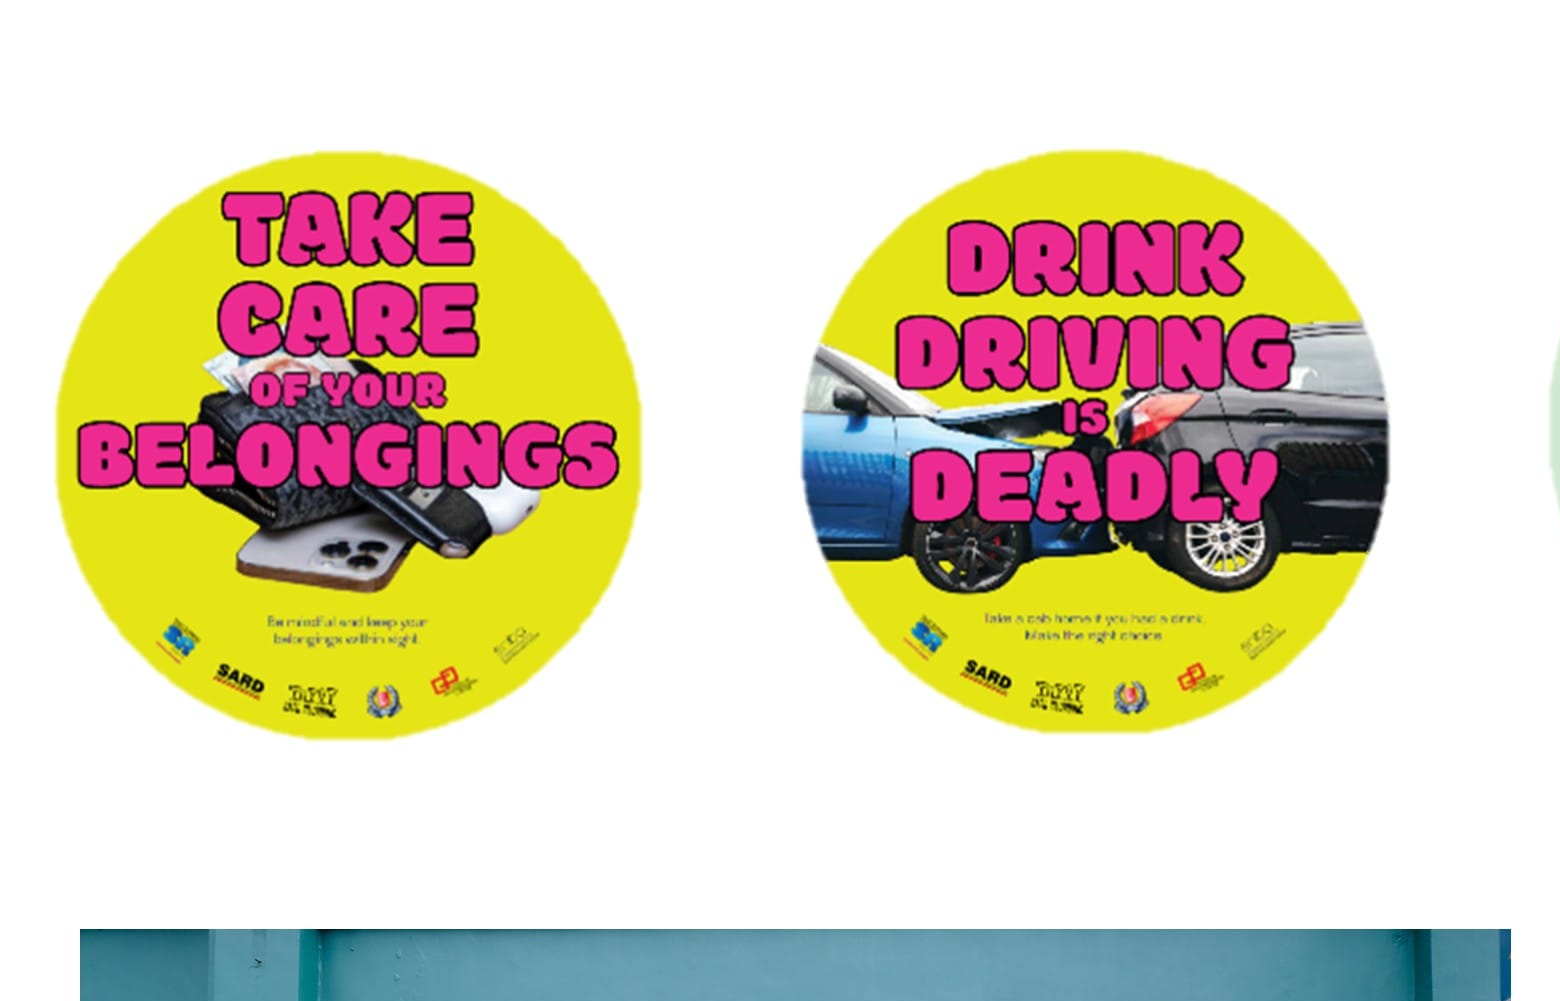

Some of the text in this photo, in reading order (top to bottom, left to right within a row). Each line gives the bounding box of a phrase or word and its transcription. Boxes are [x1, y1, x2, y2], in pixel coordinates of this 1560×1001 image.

[221, 190, 474, 266] TAKE
[947, 220, 1245, 296] DRINK
[217, 280, 479, 357] CARE
[895, 314, 1294, 392] DRIVING
[250, 372, 446, 408] OF YOUR
[1061, 399, 1109, 436] IS
[77, 421, 619, 489] BELONGINGS
[909, 448, 1280, 524] DEADLY
[217, 663, 265, 694] SARD
[964, 659, 1012, 690] SARD
